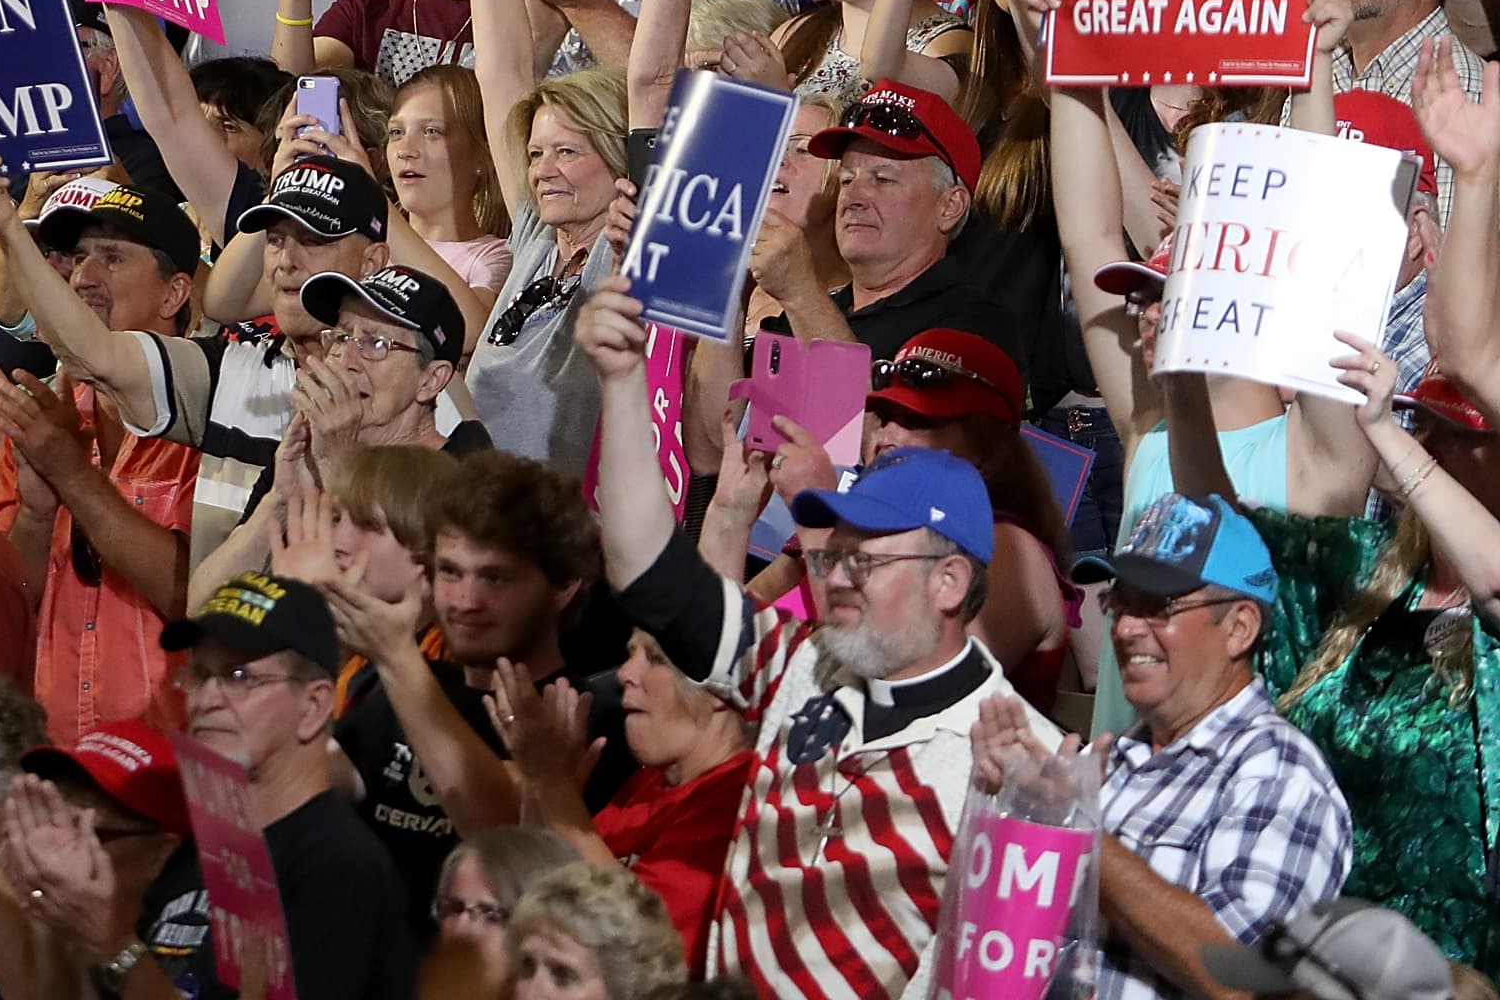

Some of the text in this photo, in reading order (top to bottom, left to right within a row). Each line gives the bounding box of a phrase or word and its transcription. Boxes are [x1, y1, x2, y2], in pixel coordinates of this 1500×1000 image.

[880, 90, 916, 108] MAKE
[274, 169, 345, 193] TRUMP
[1187, 163, 1287, 201] KEEP
[364, 269, 420, 291] UMP
[908, 346, 963, 367] AMERICA
[957, 921, 1056, 979] FOR
